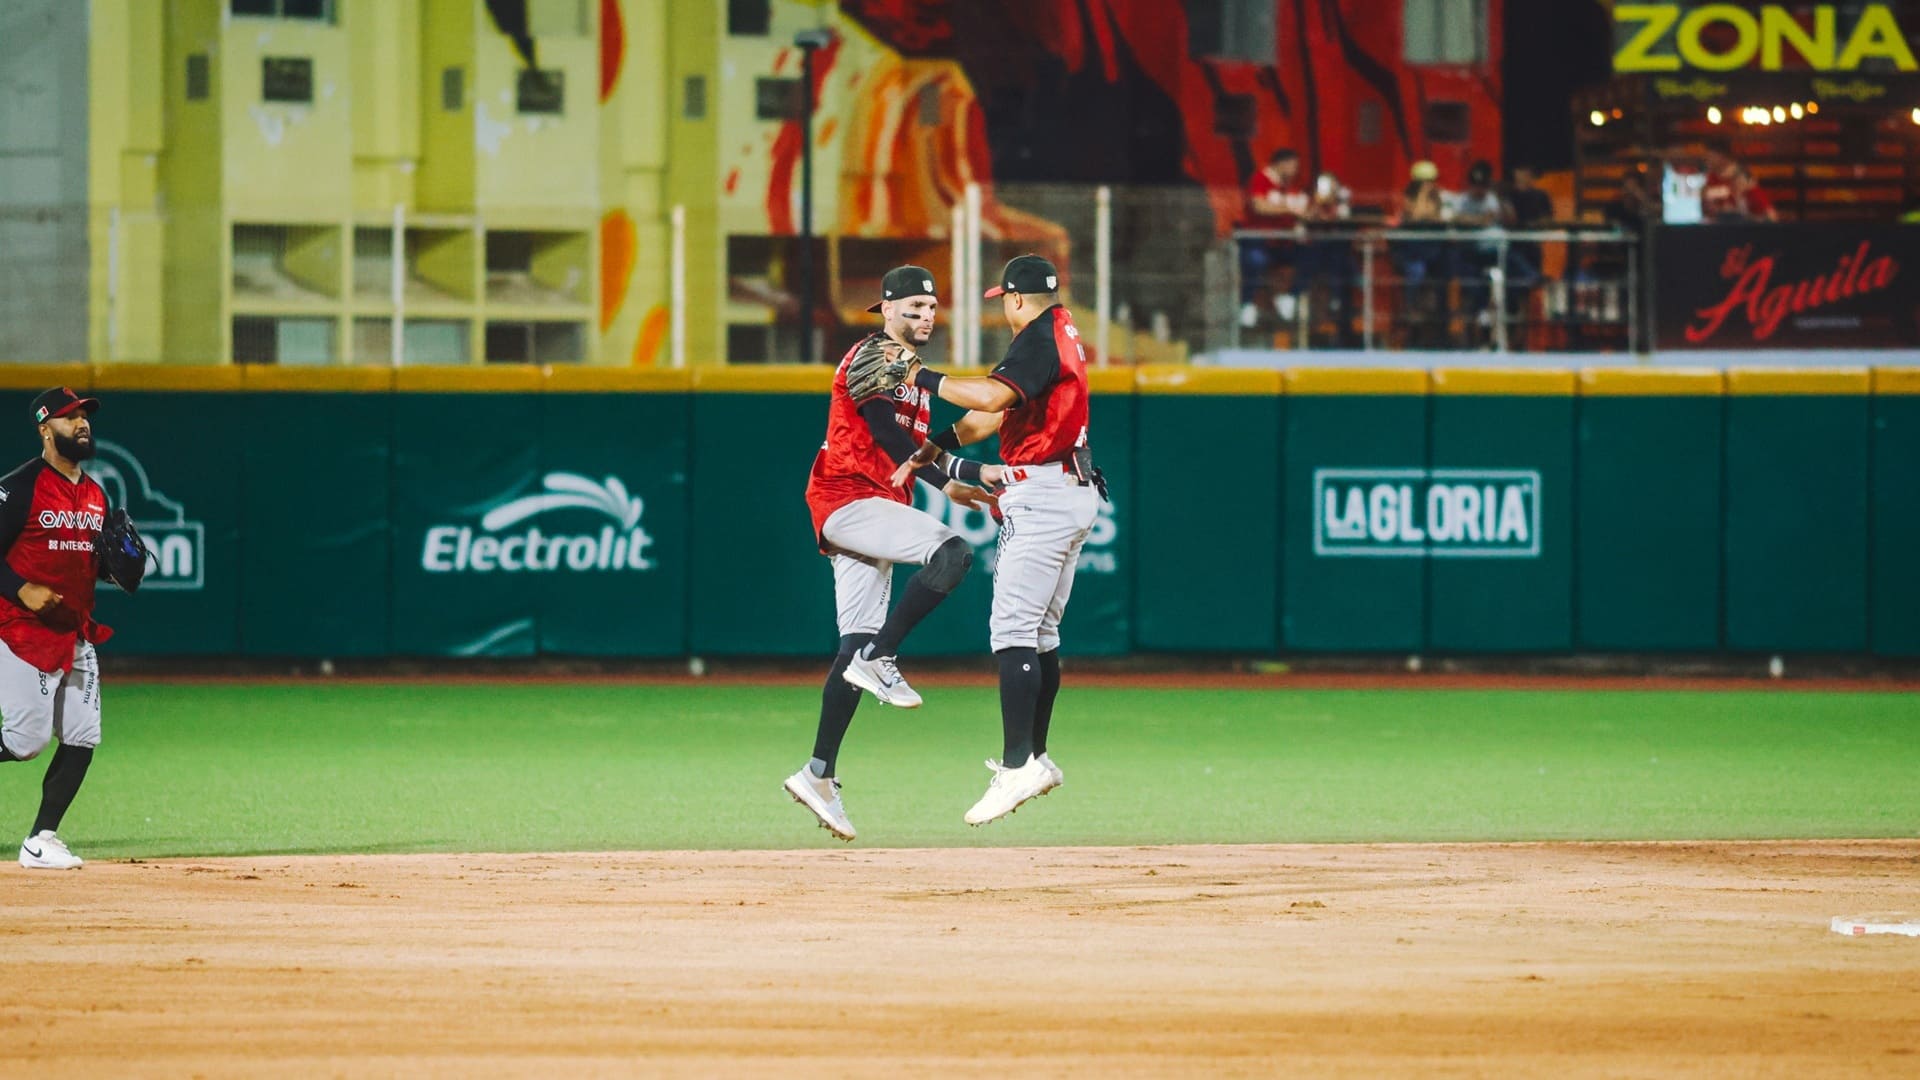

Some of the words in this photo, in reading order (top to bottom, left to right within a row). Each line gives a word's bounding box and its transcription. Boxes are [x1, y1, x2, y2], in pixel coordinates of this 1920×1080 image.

[1612, 4, 1919, 71] ZONA
[1685, 240, 1896, 342] Aguila
[38, 509, 104, 532] OAXAC
[422, 525, 653, 571] Electrolit
